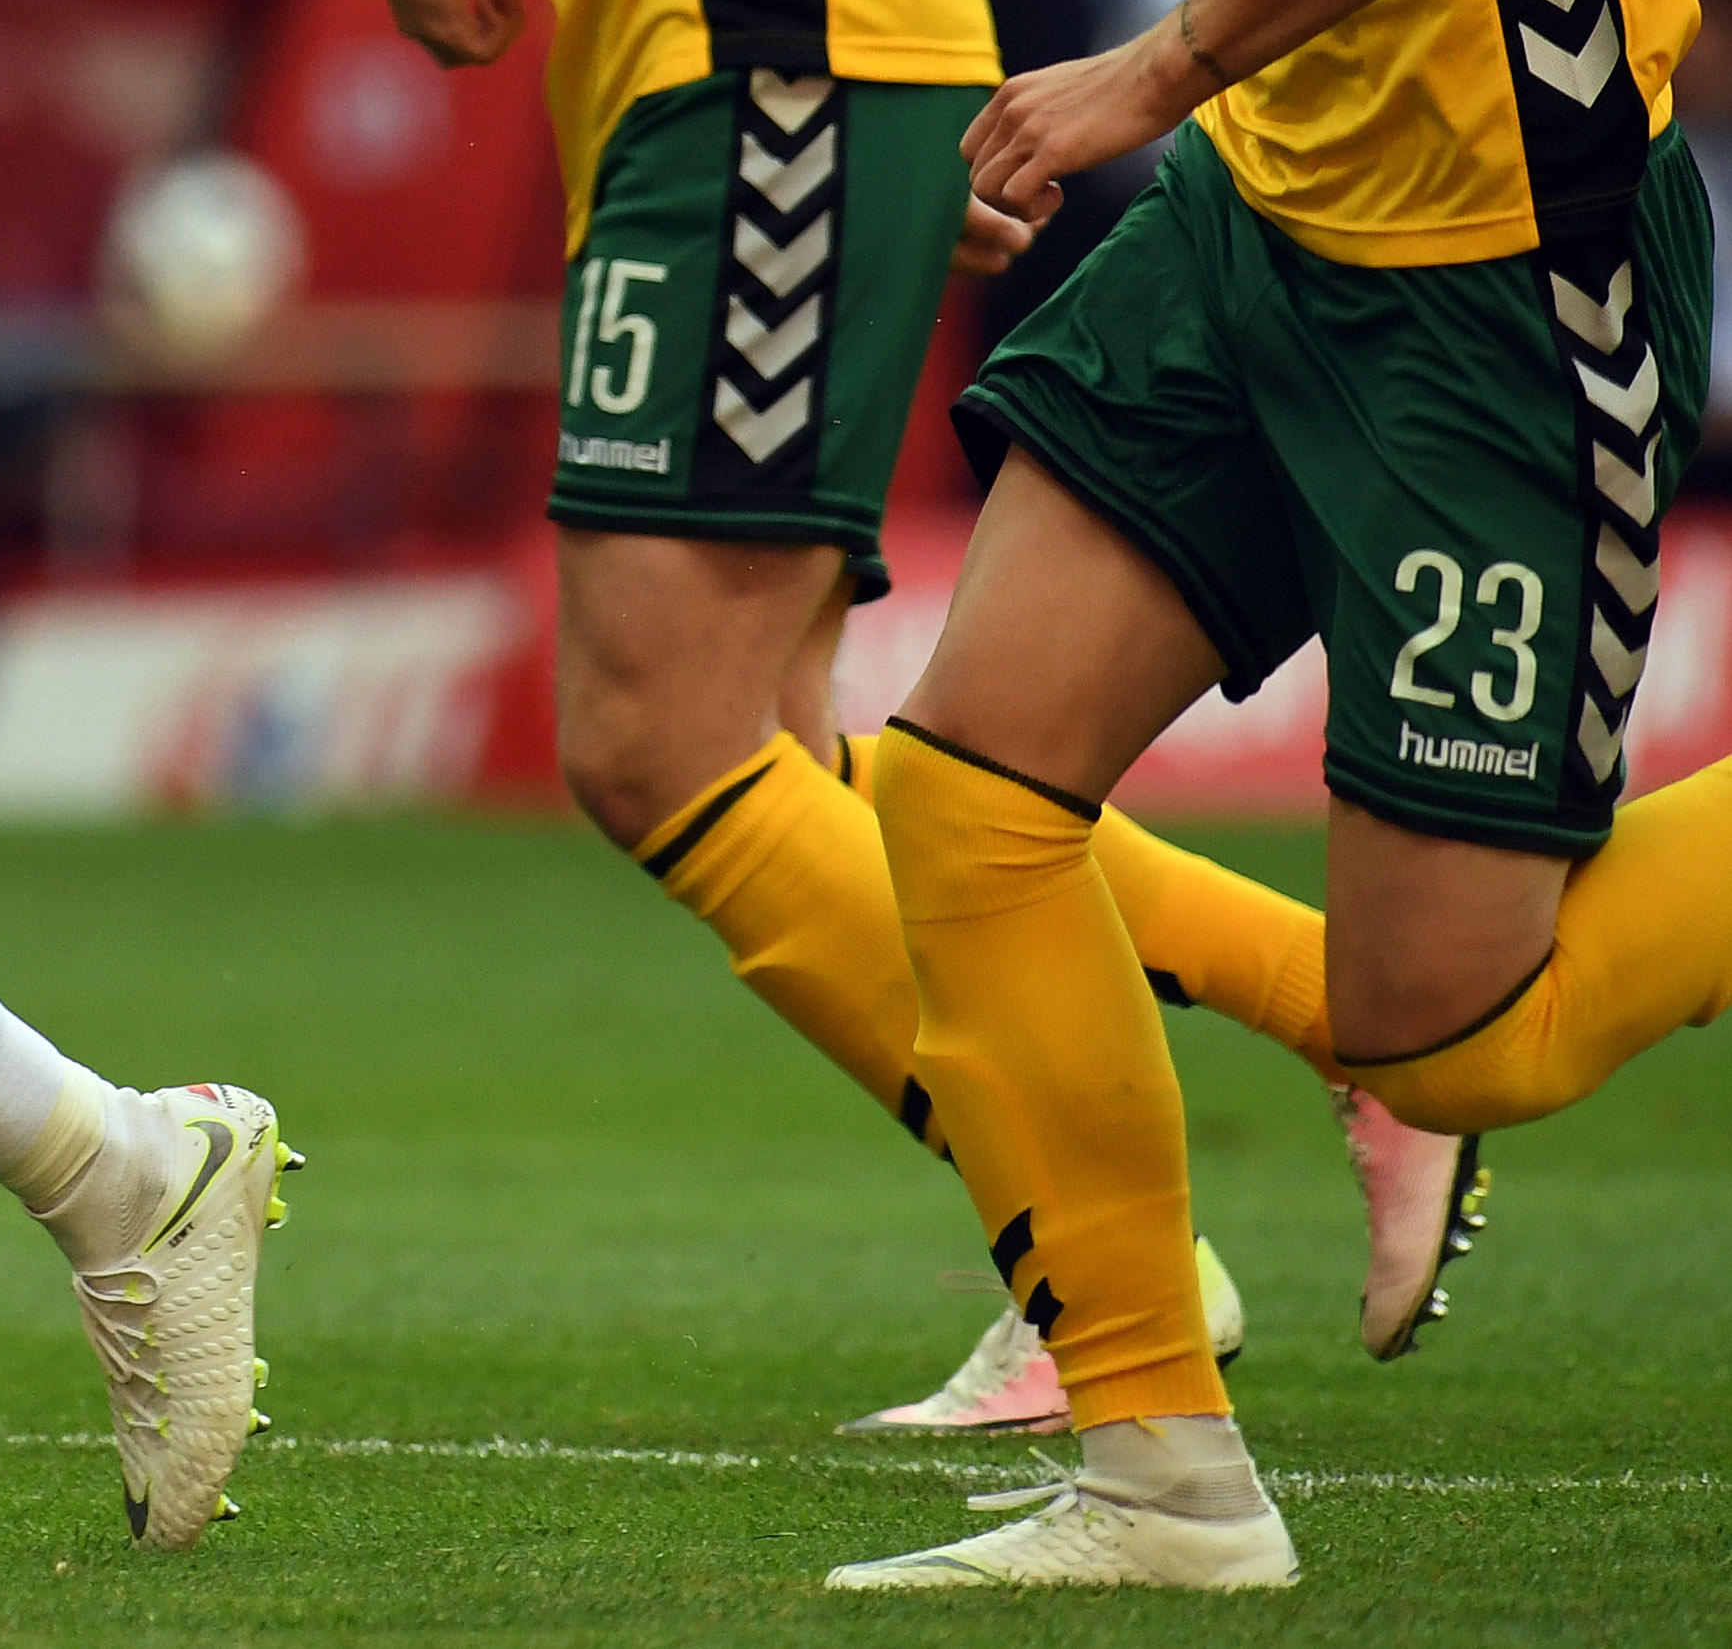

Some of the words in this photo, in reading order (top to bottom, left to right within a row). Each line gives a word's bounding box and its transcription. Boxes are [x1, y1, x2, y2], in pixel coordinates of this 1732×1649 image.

[566, 256, 669, 415] 15
[1389, 547, 1544, 723] 23
[1398, 719, 1540, 781] hummel
